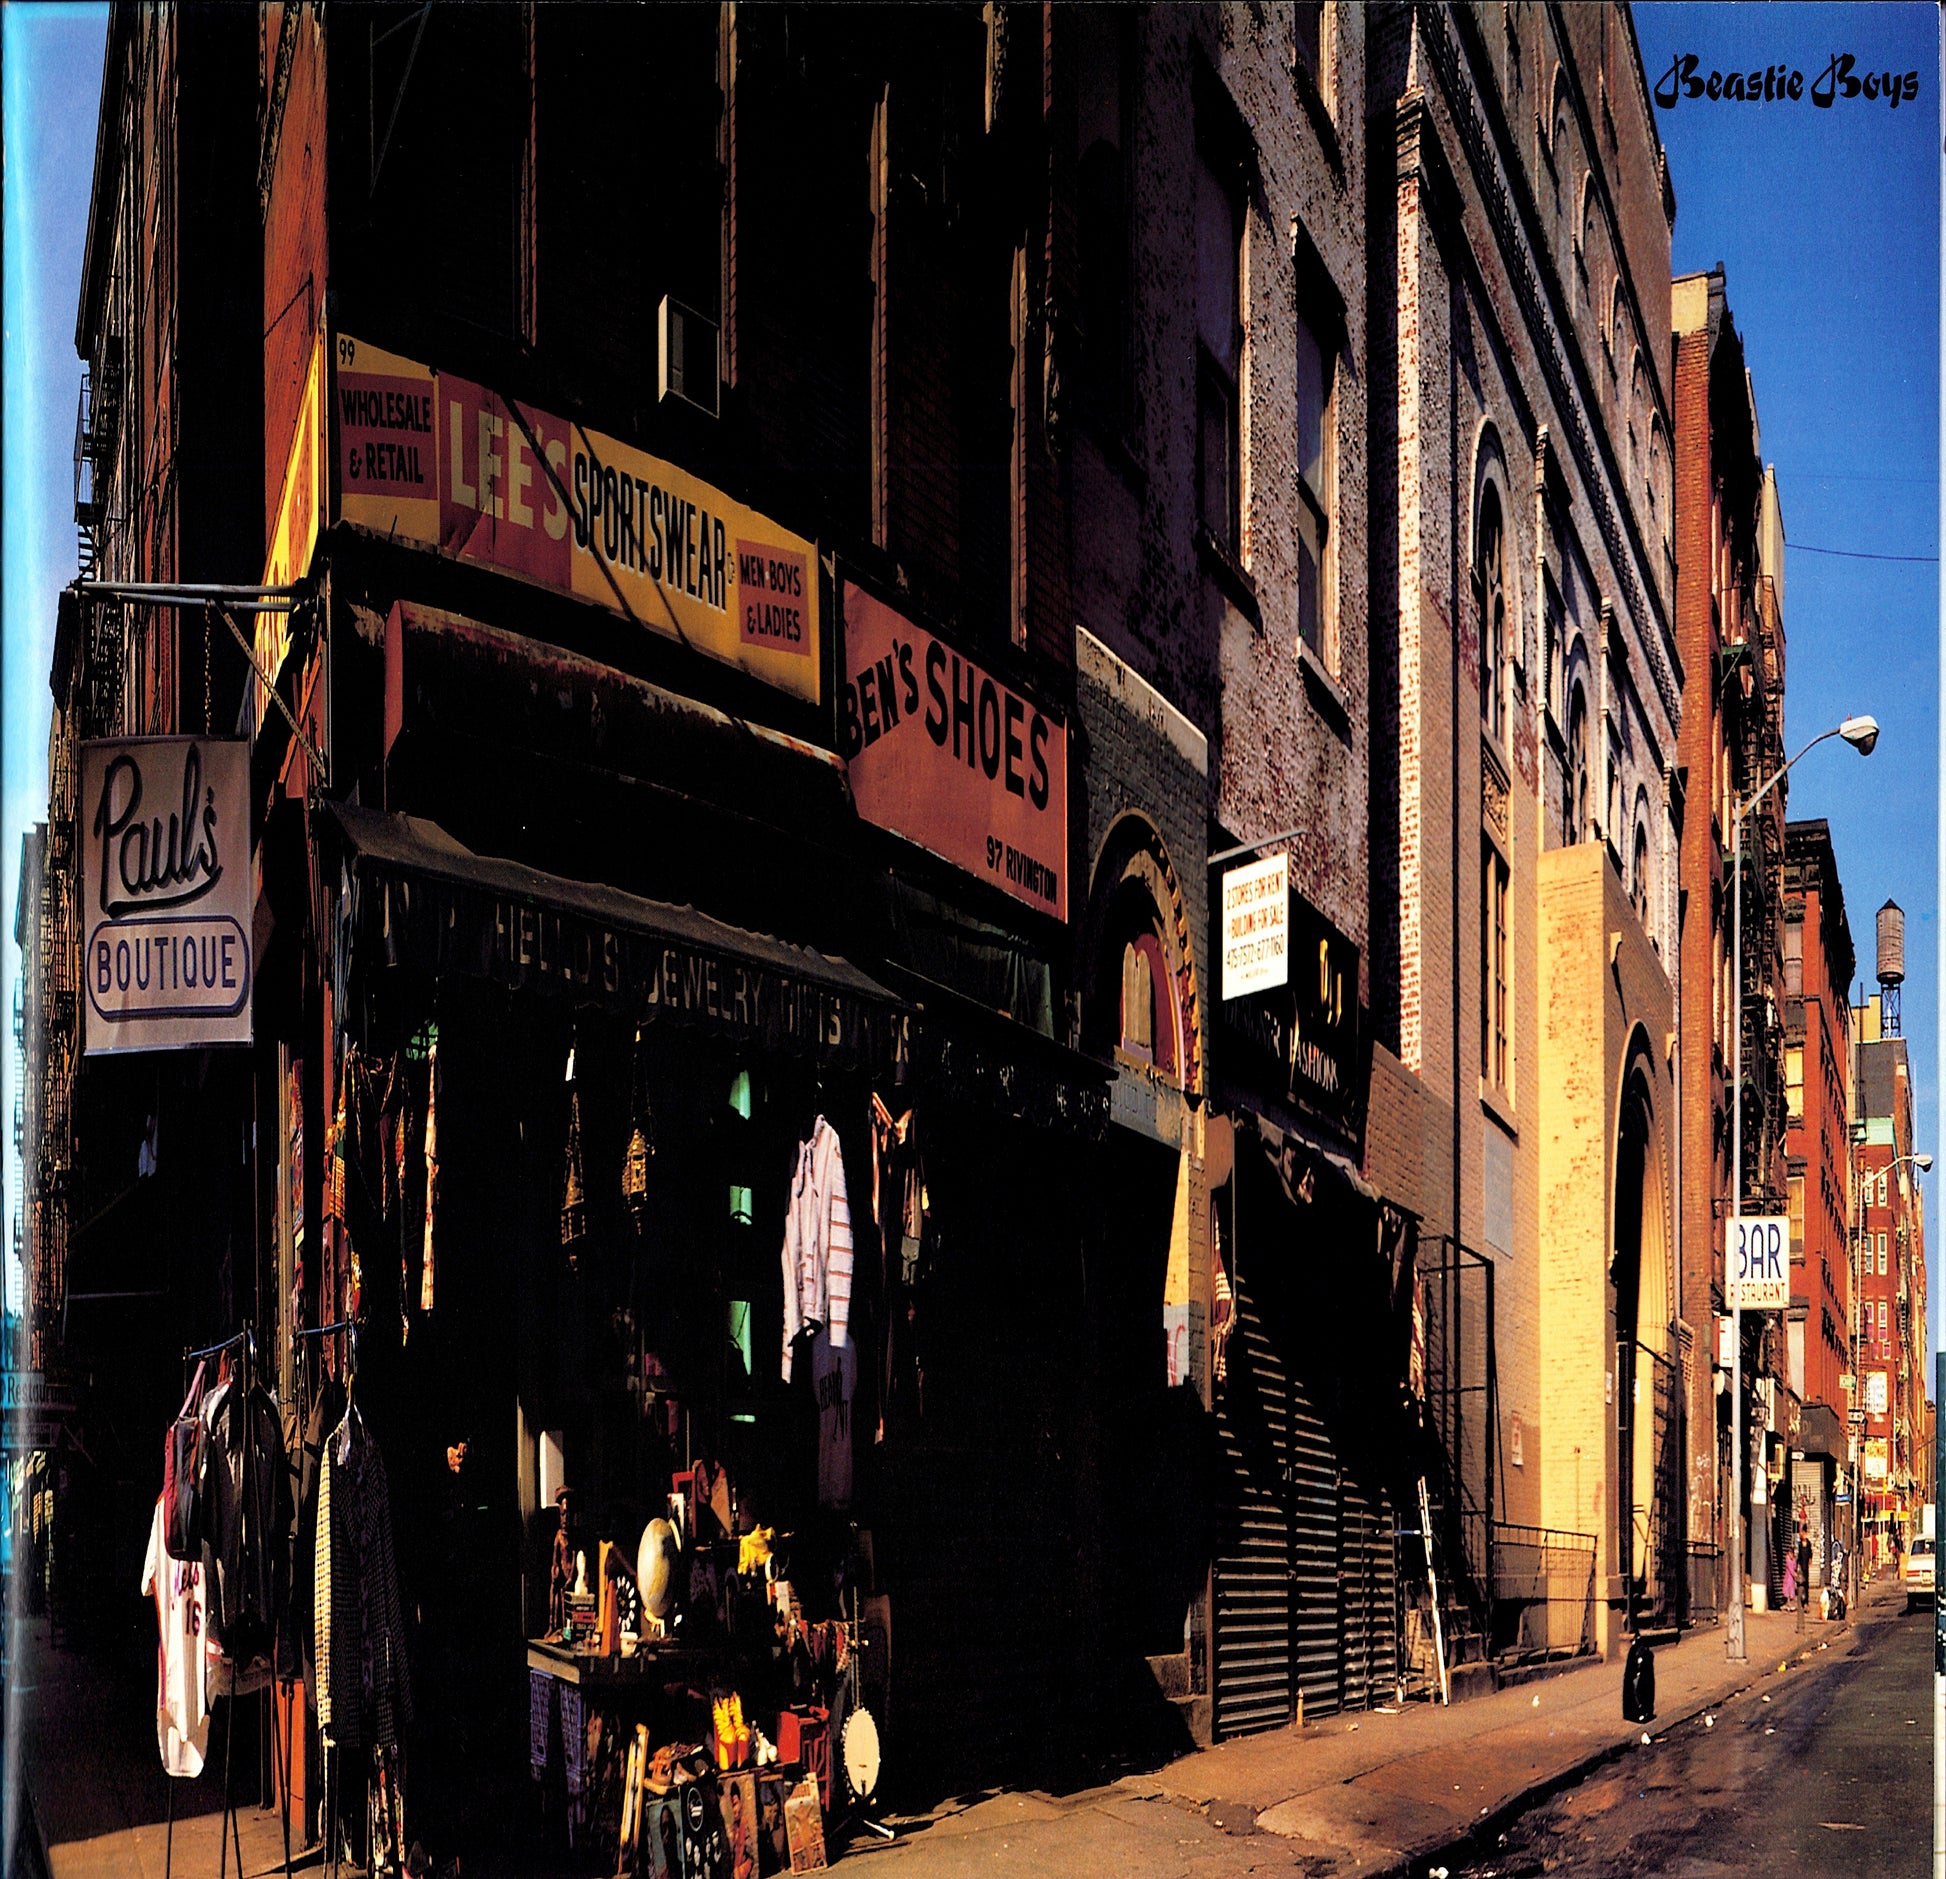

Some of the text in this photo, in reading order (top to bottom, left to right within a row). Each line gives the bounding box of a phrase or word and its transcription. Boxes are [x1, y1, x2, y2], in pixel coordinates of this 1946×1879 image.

[339, 338, 356, 367] 99
[341, 388, 432, 433] WHOLESALE
[349, 442, 424, 484] & RETAIL
[450, 400, 569, 541] LEE'S
[574, 451, 727, 615] SPORTSWEAR
[845, 638, 1049, 812] BEN'S SHOES
[94, 742, 224, 919] Paul's
[986, 835, 1058, 905] 97 RIVINGTON
[1231, 881, 1253, 909] STORES
[1255, 877, 1266, 899] FOR
[1267, 869, 1284, 895] RENT
[1258, 907, 1268, 930] FOR
[1270, 902, 1284, 927] SALE
[97, 935, 236, 993] BOUTIQUE
[1730, 1283, 1785, 1302] RSTAURANT
[185, 1598, 202, 1637] 16
